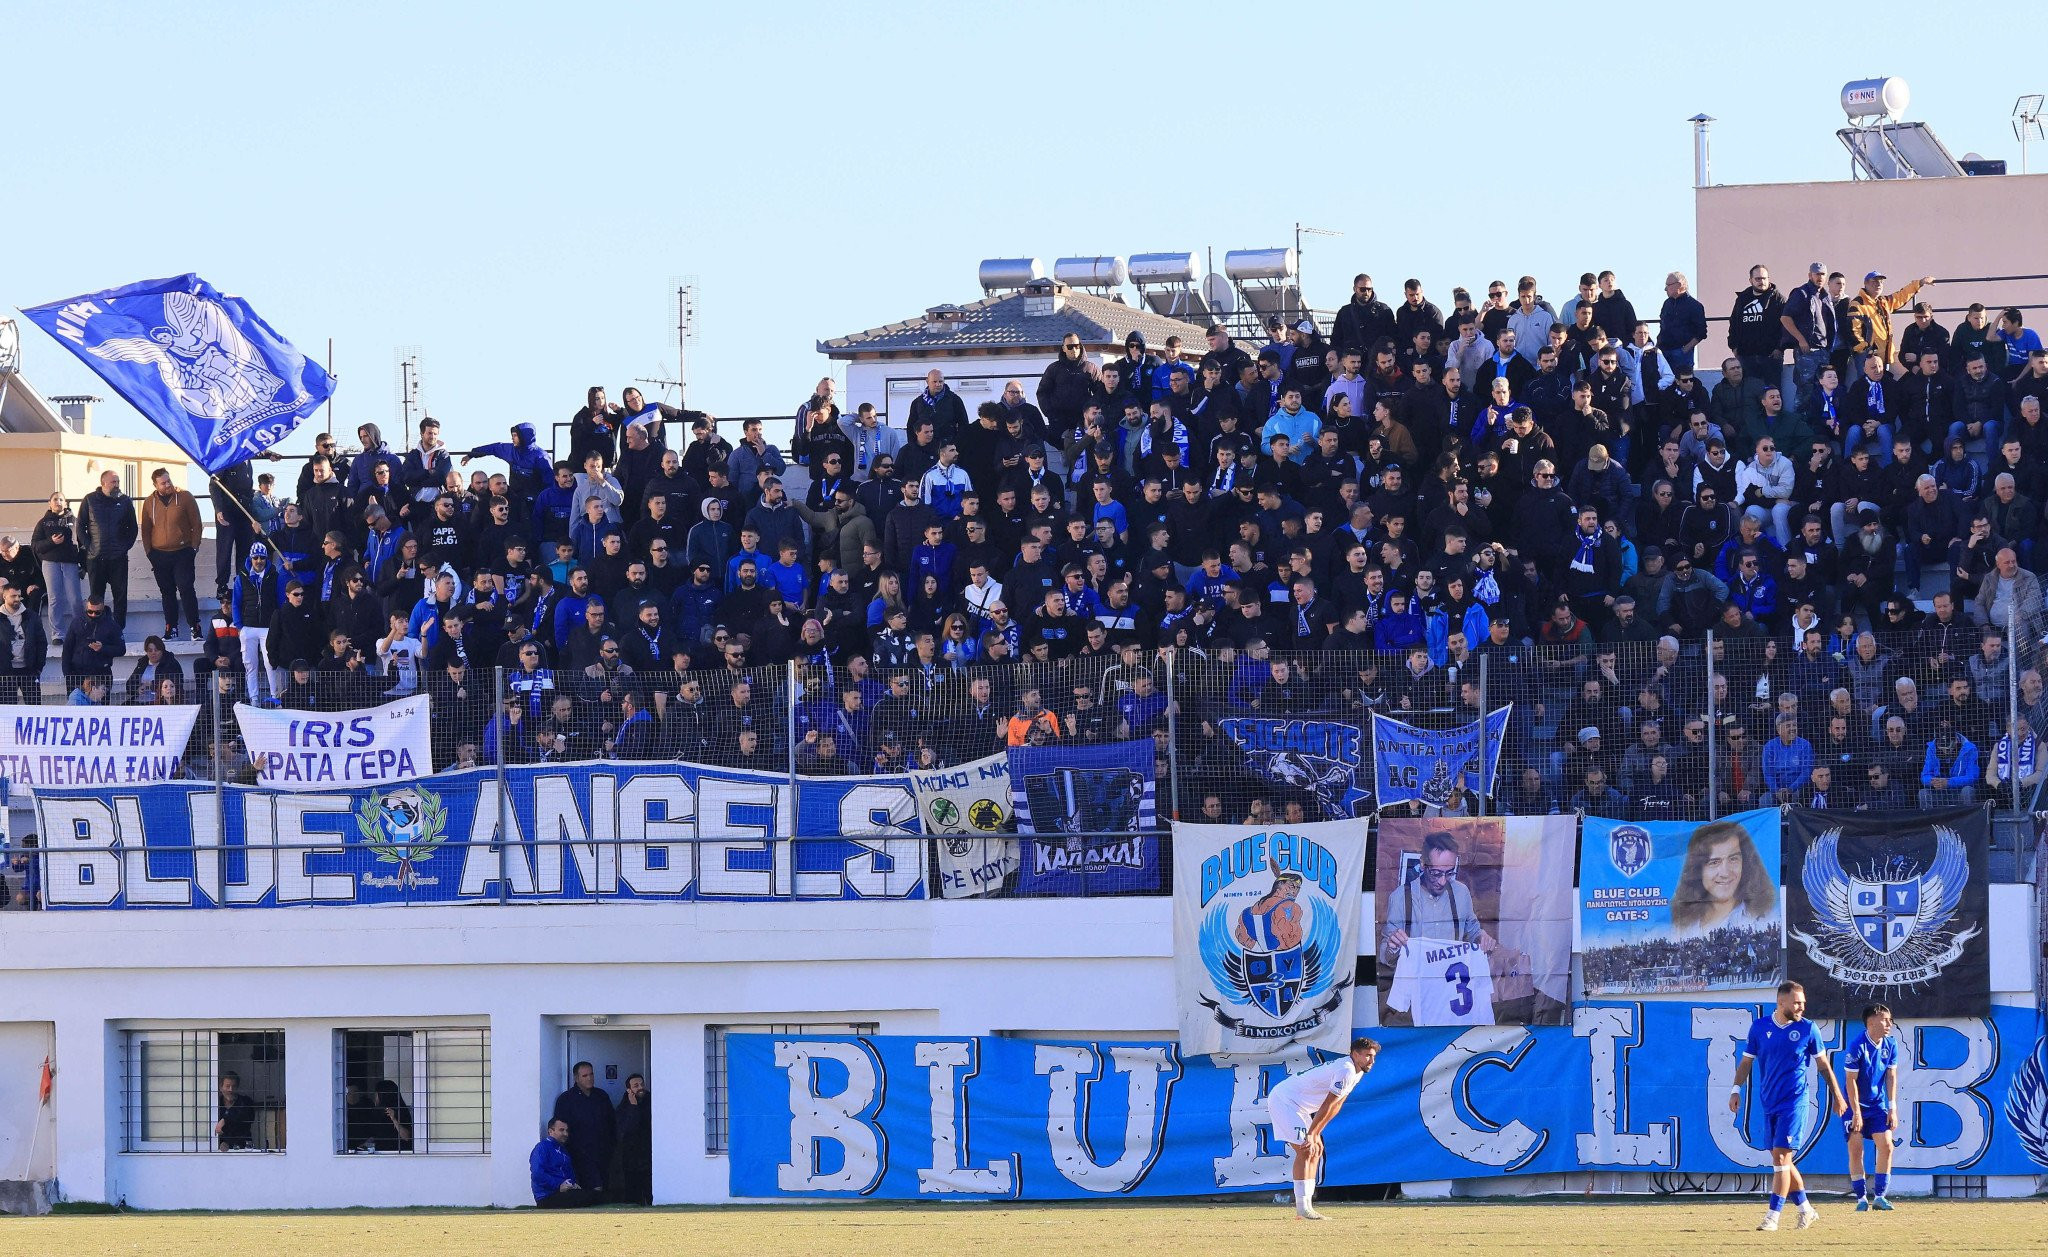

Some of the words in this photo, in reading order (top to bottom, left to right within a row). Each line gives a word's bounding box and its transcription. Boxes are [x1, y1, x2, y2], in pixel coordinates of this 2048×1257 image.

[56, 298, 117, 346] ΝΙΚ
[405, 708, 414, 716] 94
[15, 716, 112, 746] ΜΗΤΣΑΡΑ
[119, 717, 165, 746] ΓΕΡΑ
[288, 716, 375, 748] IRIS
[39, 755, 117, 784] ΠΕΤΑΛΑ
[251, 750, 335, 781] ΚΡΑΤΑ
[344, 748, 417, 780] ΓΕΡΑ
[38, 793, 357, 905] BLUE
[460, 773, 923, 898] ANGELS
[1201, 833, 1267, 908] BLUE
[1269, 832, 1337, 900] CLUB
[1593, 888, 1625, 899] BLUE
[1628, 887, 1660, 898] CLUB
[1606, 910, 1649, 921] GATE-3
[1445, 961, 1474, 1017] 3
[774, 1040, 1322, 1196] BLUE
[1419, 1005, 1998, 1171] CLUB
